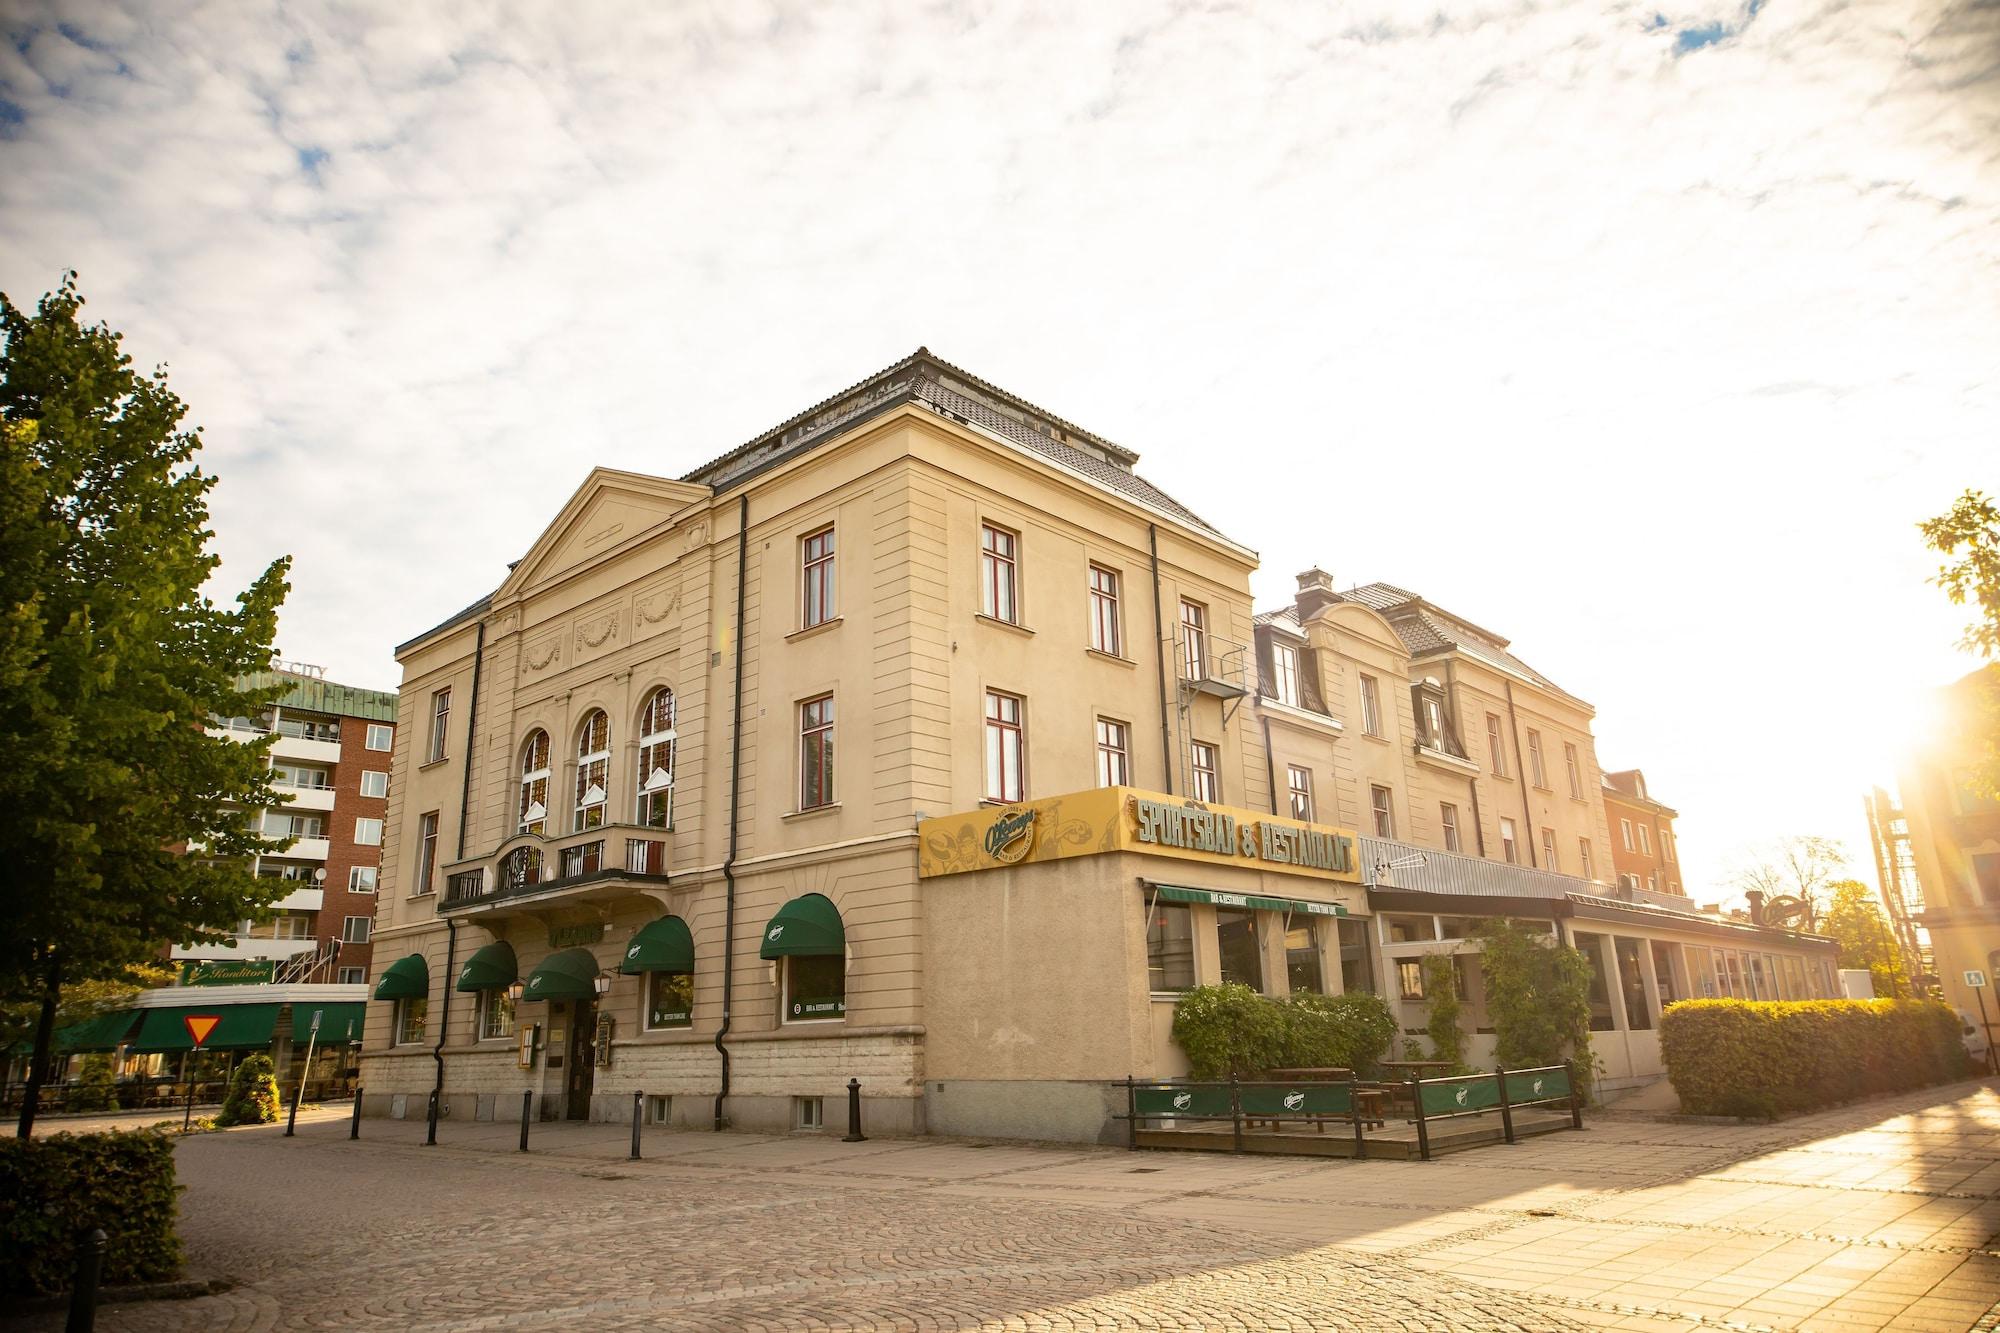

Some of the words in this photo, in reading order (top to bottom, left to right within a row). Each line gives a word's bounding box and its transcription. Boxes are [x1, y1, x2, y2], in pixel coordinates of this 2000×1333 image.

[290, 661, 328, 679] CITY
[1137, 799, 1236, 855] SPORTSBAR
[1241, 823, 1257, 857] &
[1260, 821, 1353, 872] RESTAURANT
